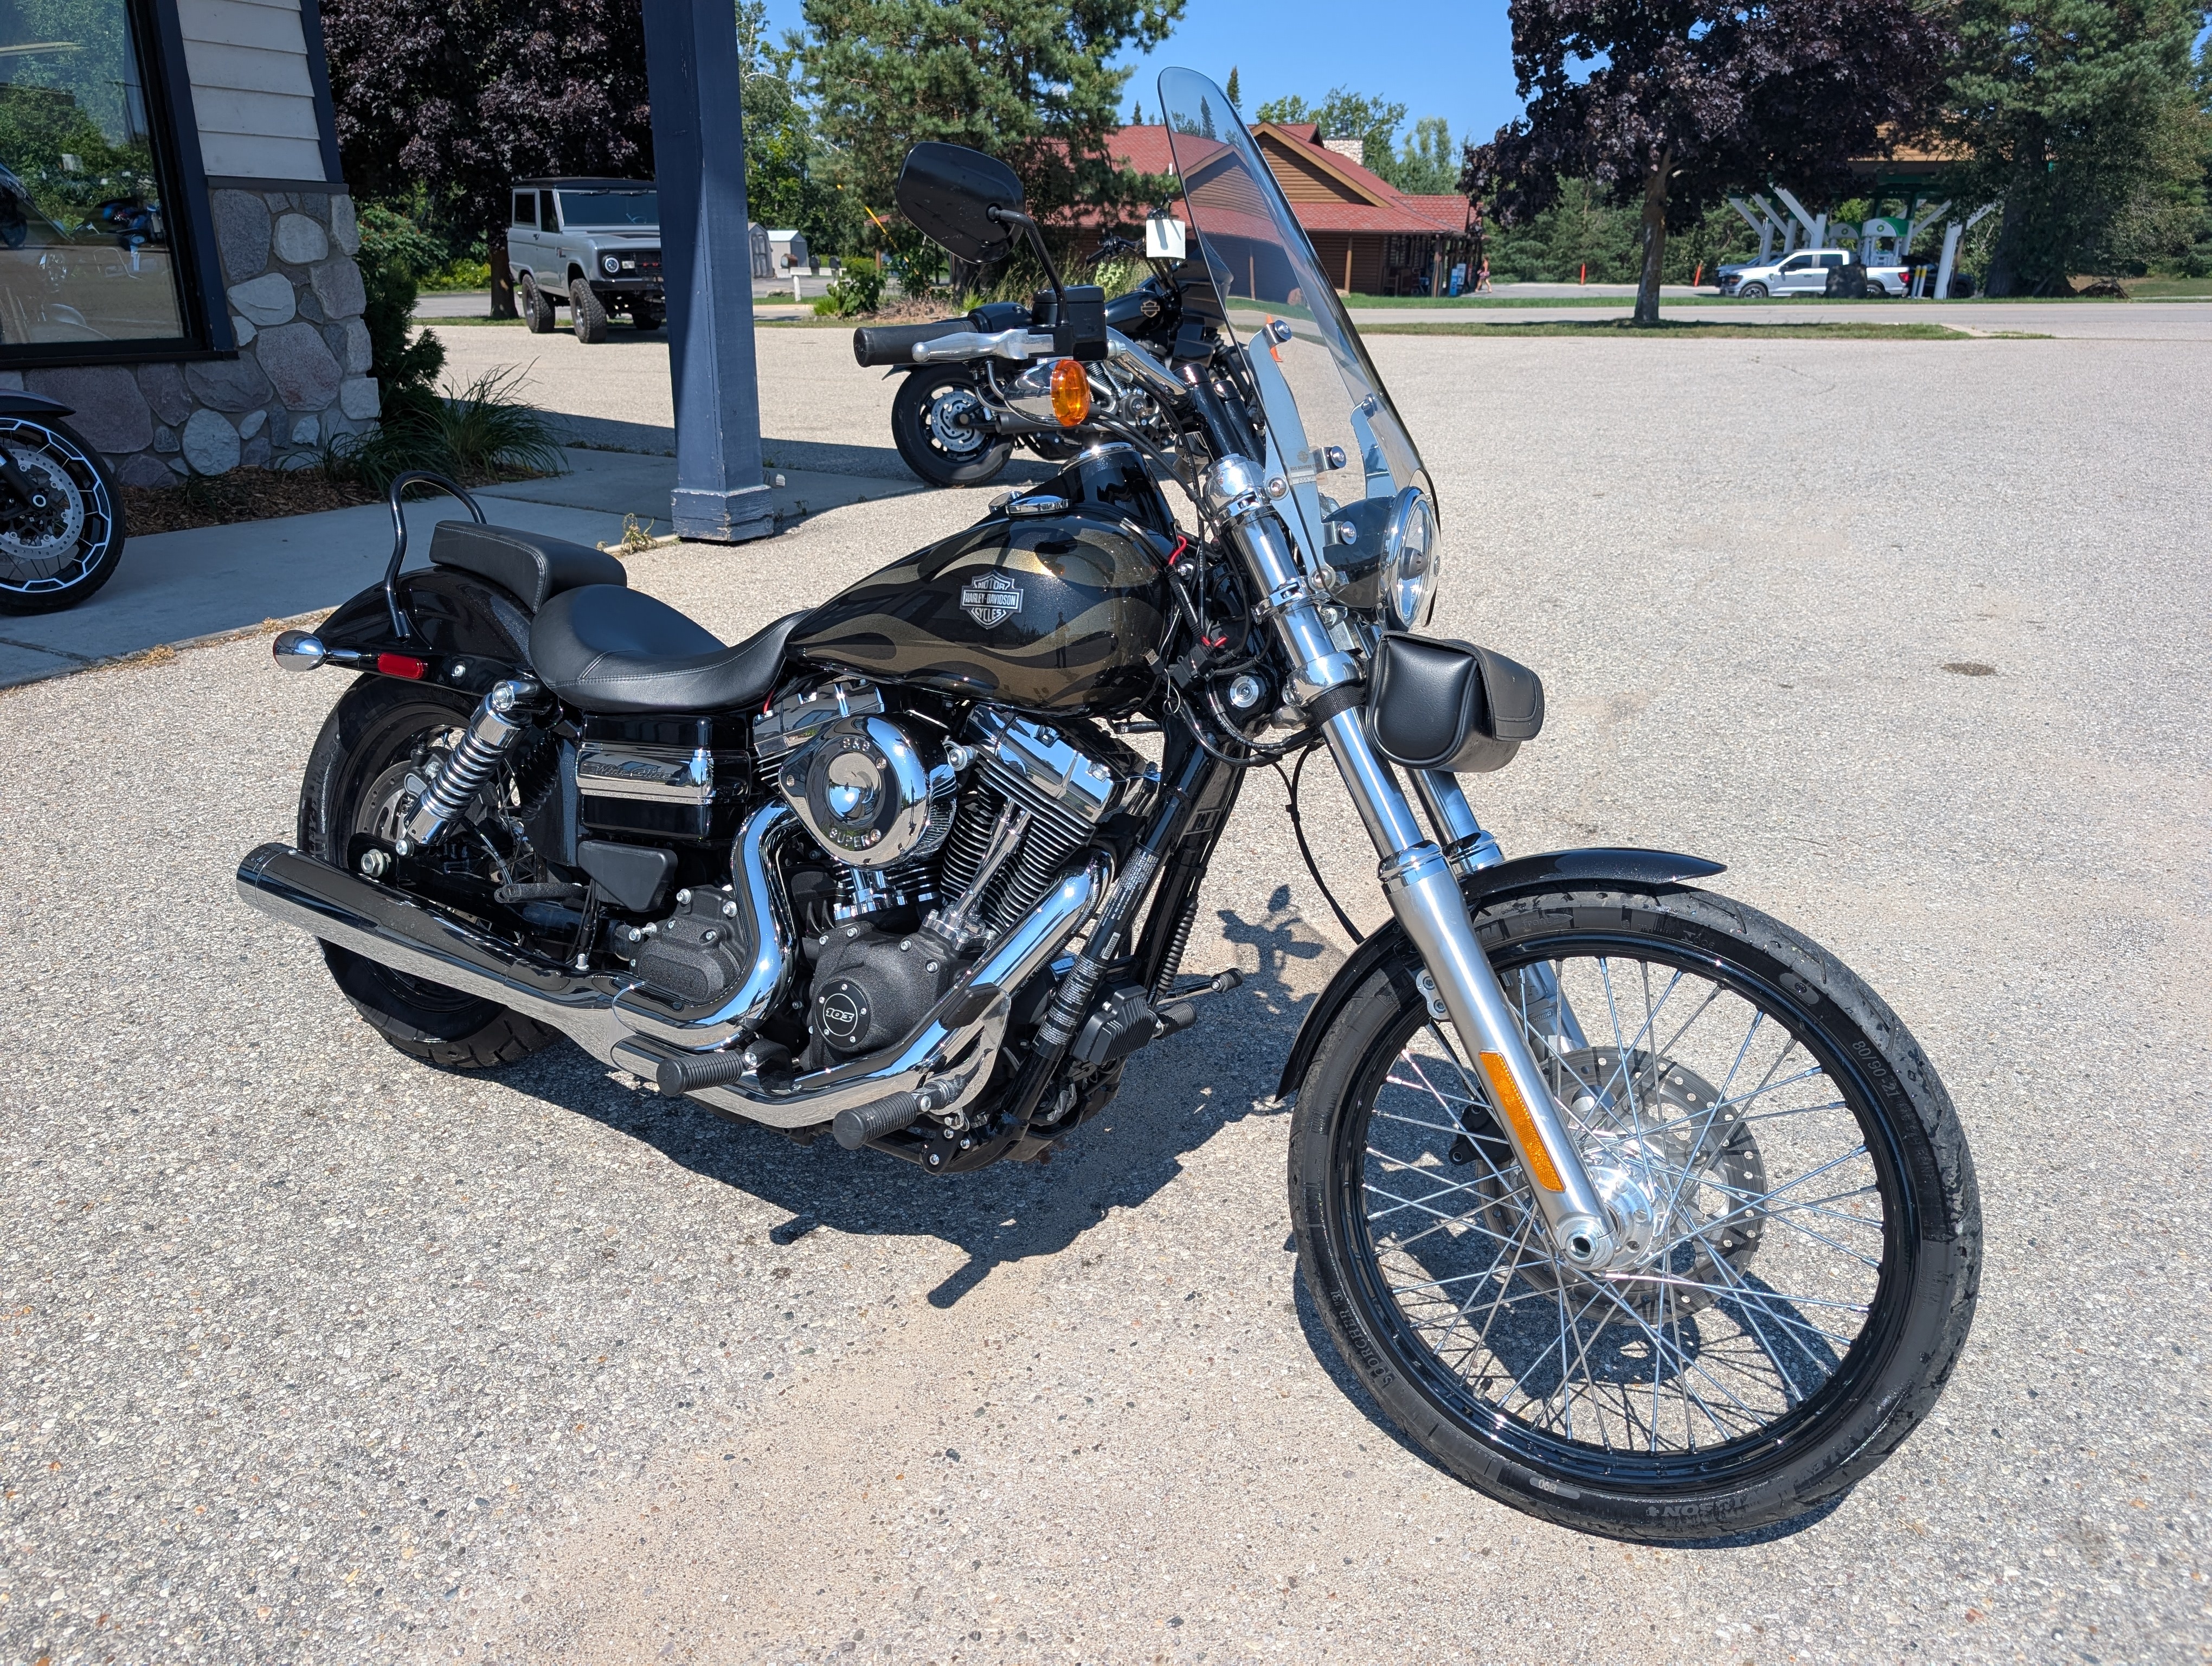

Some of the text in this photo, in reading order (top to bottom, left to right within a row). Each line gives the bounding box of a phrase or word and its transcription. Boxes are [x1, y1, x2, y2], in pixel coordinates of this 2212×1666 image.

[978, 578, 1006, 591] MOTOR
[965, 592, 1016, 606] HARLEY-DAVIDSON
[974, 607, 1002, 622] CYCLES
[591, 763, 676, 780] Wide Glide
[1521, 915, 1552, 929] front
[826, 1007, 854, 1022] 103
[1529, 1010, 1553, 1023] SHOWA
[1852, 1040, 1899, 1098] 80/90-21
[1339, 1309, 1396, 1389] SCORCHER
[1536, 1477, 1557, 1494] B90
